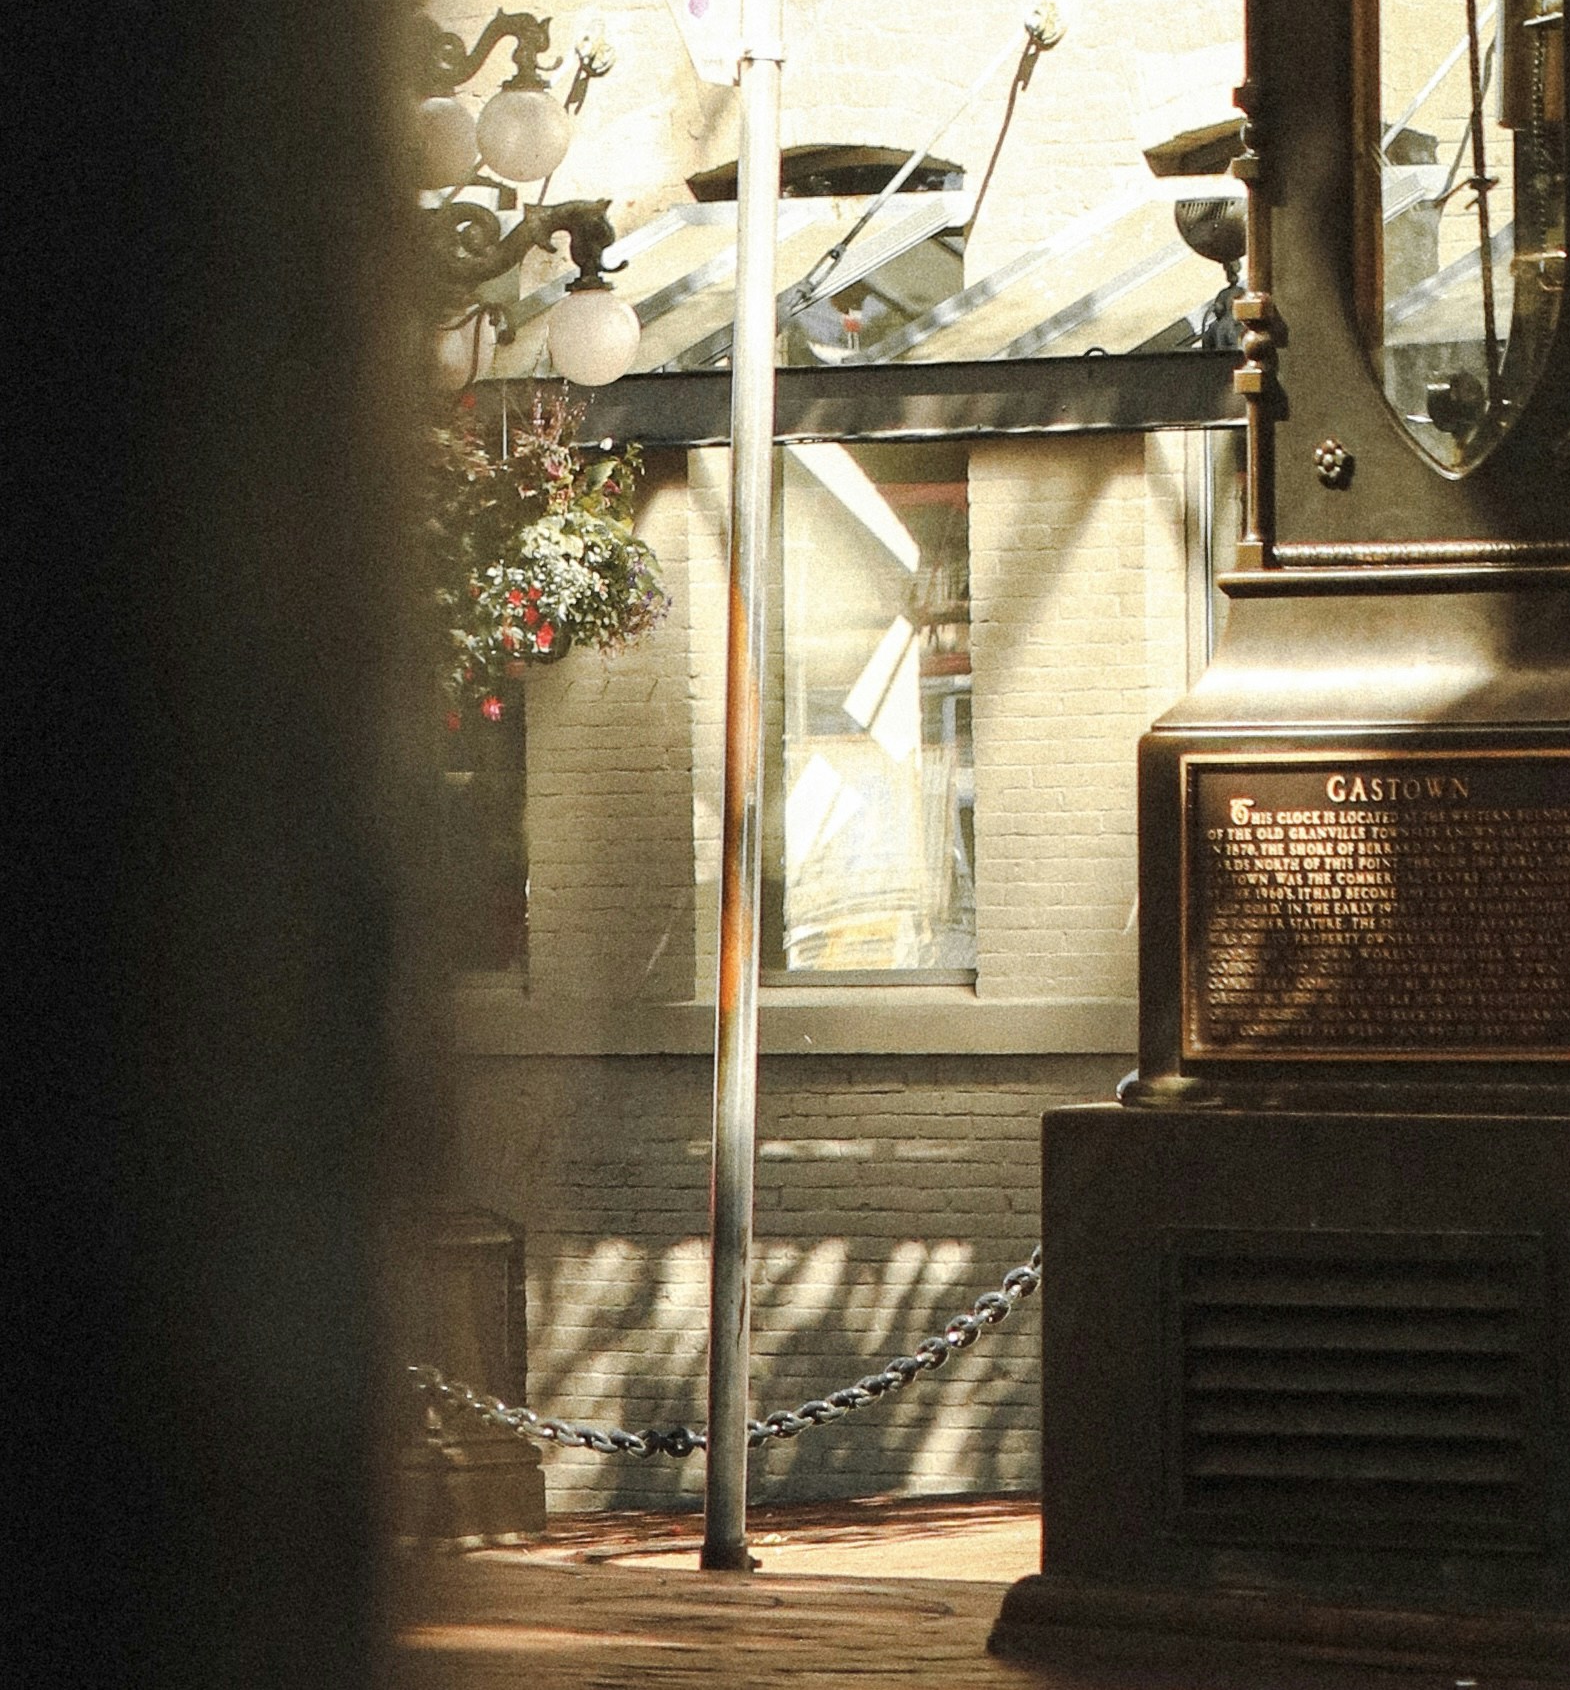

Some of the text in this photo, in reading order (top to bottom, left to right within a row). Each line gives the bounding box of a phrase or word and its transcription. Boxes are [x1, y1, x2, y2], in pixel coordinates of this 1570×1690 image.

[1326, 774, 1470, 803] GASTOWN
[1230, 798, 1273, 826] THIS
[1277, 811, 1320, 825] CLOCK
[1323, 811, 1336, 825] IS
[1339, 810, 1397, 824] LOCATED
[1208, 828, 1224, 840] OF
[1227, 827, 1252, 840] THE
[1256, 827, 1284, 840] OLD
[1288, 826, 1366, 840] GRANVILLE
[1261, 843, 1285, 856] THE
[1289, 843, 1334, 856] SHORE
[1338, 843, 1355, 855] OF
[1212, 859, 1251, 871] ARDS
[1254, 858, 1300, 870] NORTH
[1304, 858, 1320, 870] OF
[1324, 858, 1354, 870] THIS
[1275, 873, 1303, 885] WAS
[1307, 873, 1332, 885] THE
[1298, 888, 1310, 900] IT
[1311, 887, 1341, 899] HAD
[1345, 887, 1398, 900] BECOME
[1288, 903, 1302, 915] IN
[1306, 902, 1330, 914] THE
[1334, 902, 1374, 915] EARLY
[1352, 918, 1376, 930] THE
[1295, 933, 1359, 944] PROPERTY
